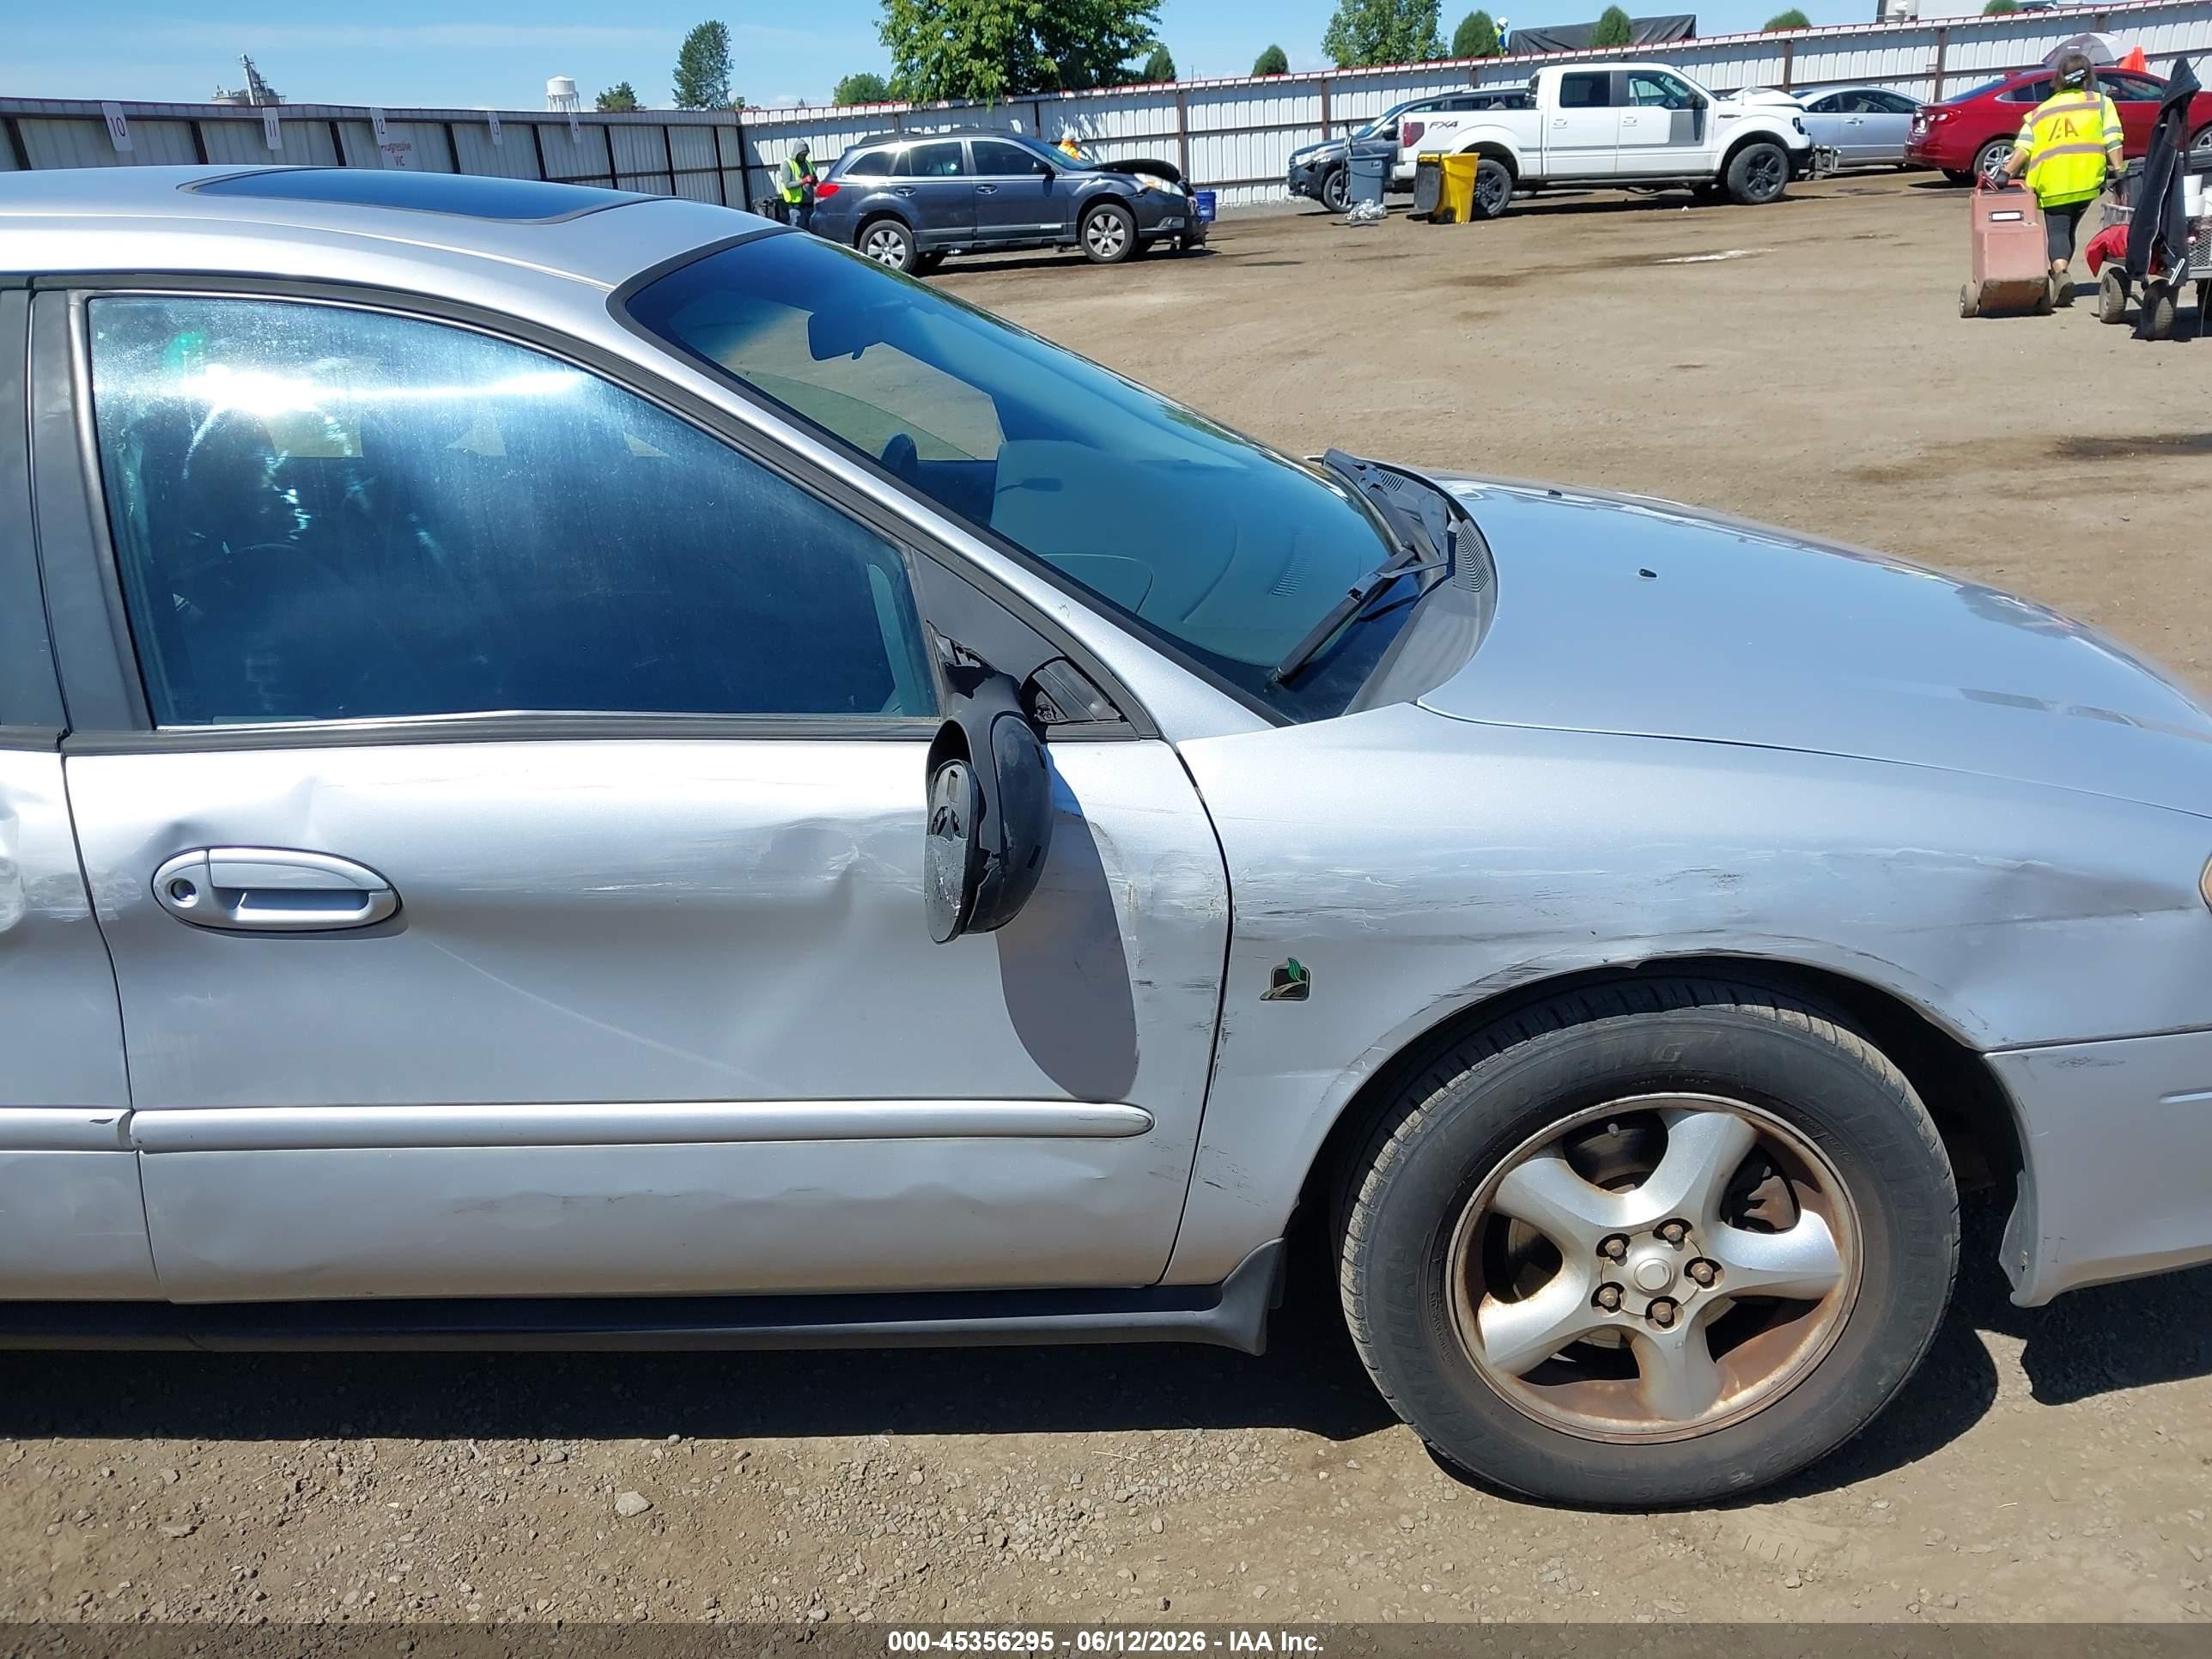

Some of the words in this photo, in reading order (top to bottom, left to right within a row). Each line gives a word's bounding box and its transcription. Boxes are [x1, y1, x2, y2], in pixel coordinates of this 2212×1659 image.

[109, 116, 126, 137] 10
[267, 119, 277, 137] 11
[374, 118, 386, 135] 12
[1429, 120, 1459, 130] FX4
